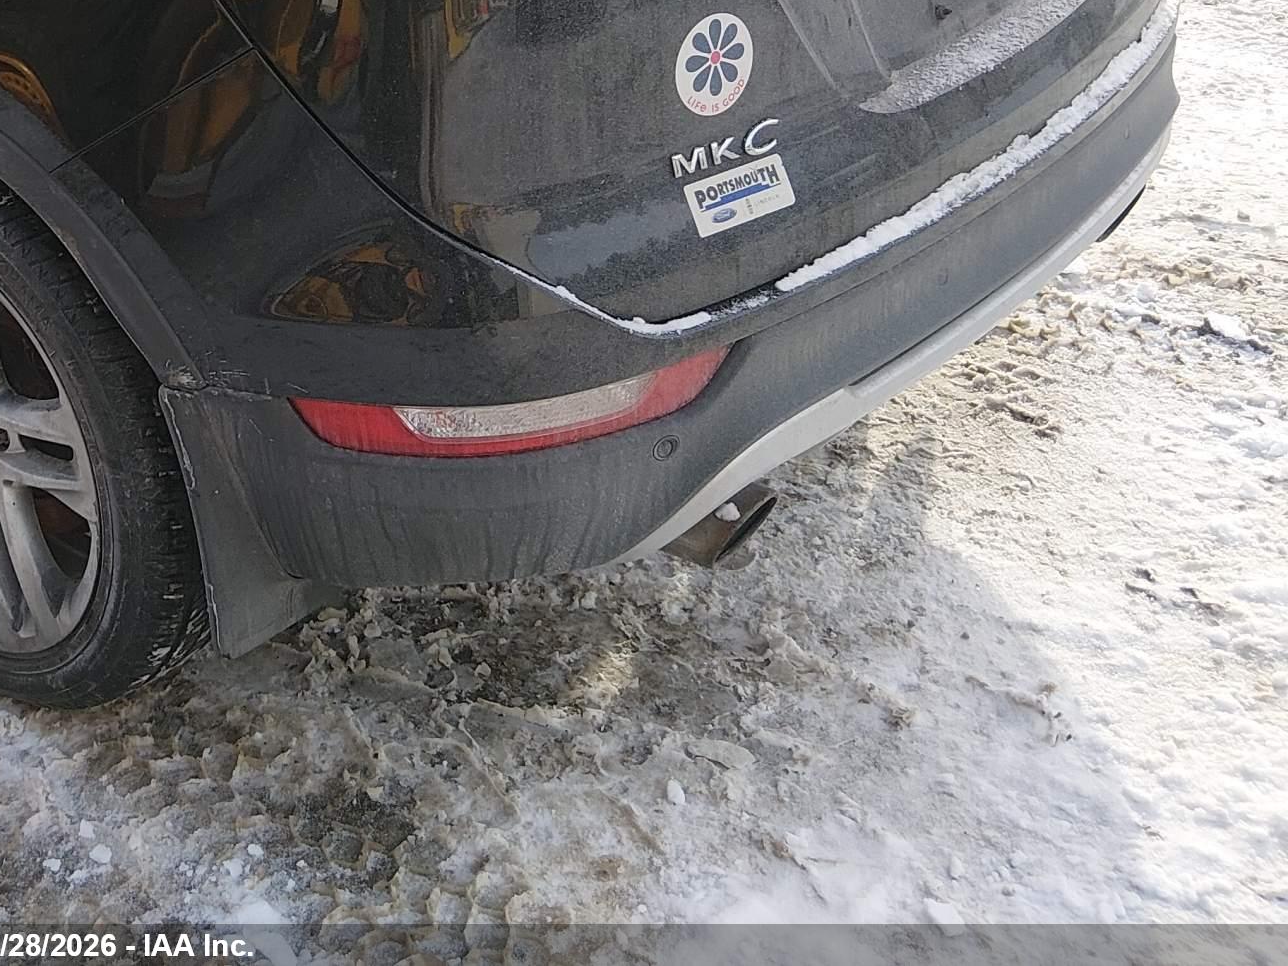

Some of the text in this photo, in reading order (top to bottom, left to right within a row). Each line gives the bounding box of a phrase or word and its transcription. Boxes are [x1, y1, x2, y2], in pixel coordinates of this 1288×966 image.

[722, 78, 745, 107] GOOD
[670, 118, 779, 179] MKC
[694, 164, 781, 210] PORTSMOUTH
